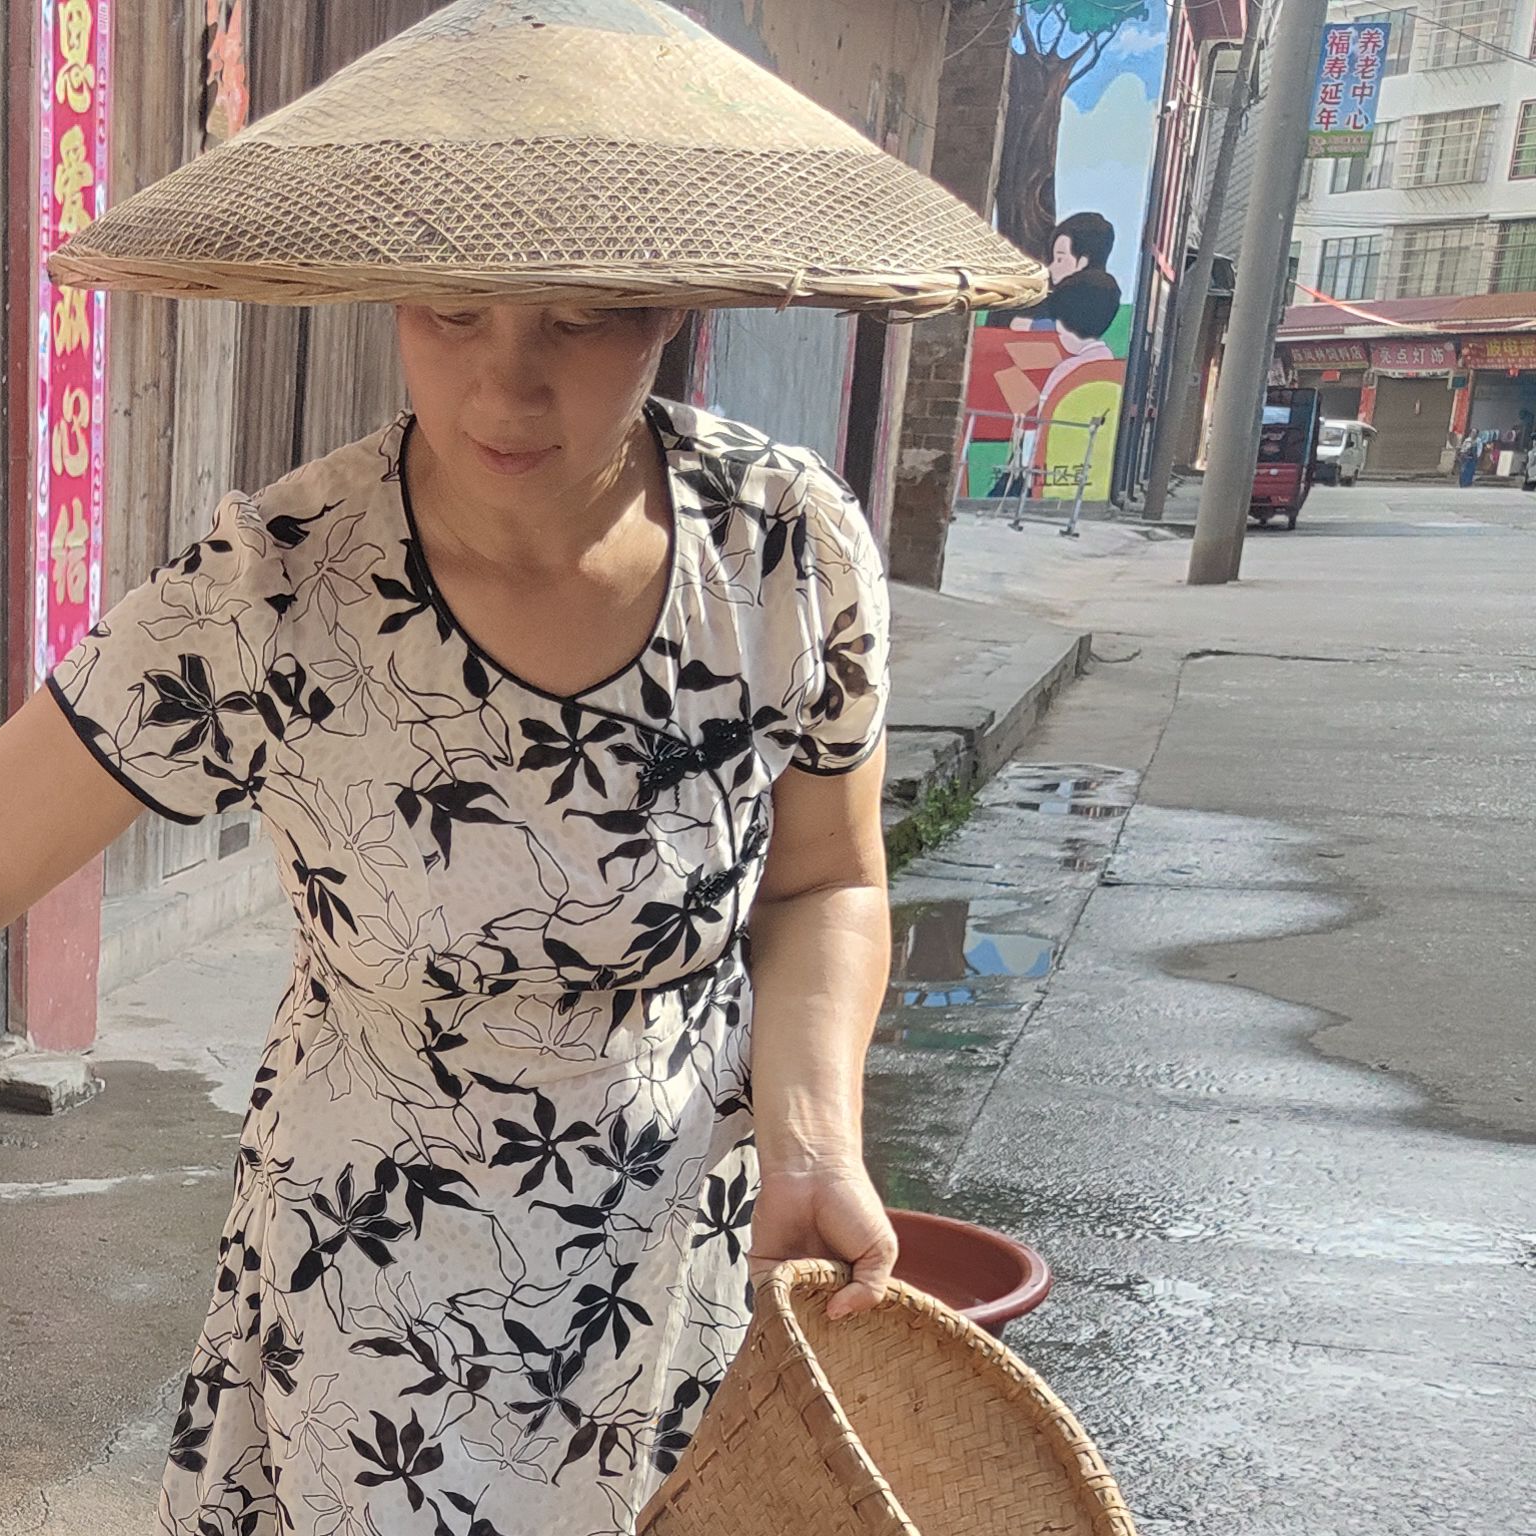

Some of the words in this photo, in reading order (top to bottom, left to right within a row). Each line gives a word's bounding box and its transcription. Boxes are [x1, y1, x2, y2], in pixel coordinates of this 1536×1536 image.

[1314, 30, 1352, 131] 福寿延年
[1345, 28, 1385, 131] 养老中心
[1379, 347, 1444, 365] 亮点灯饰
